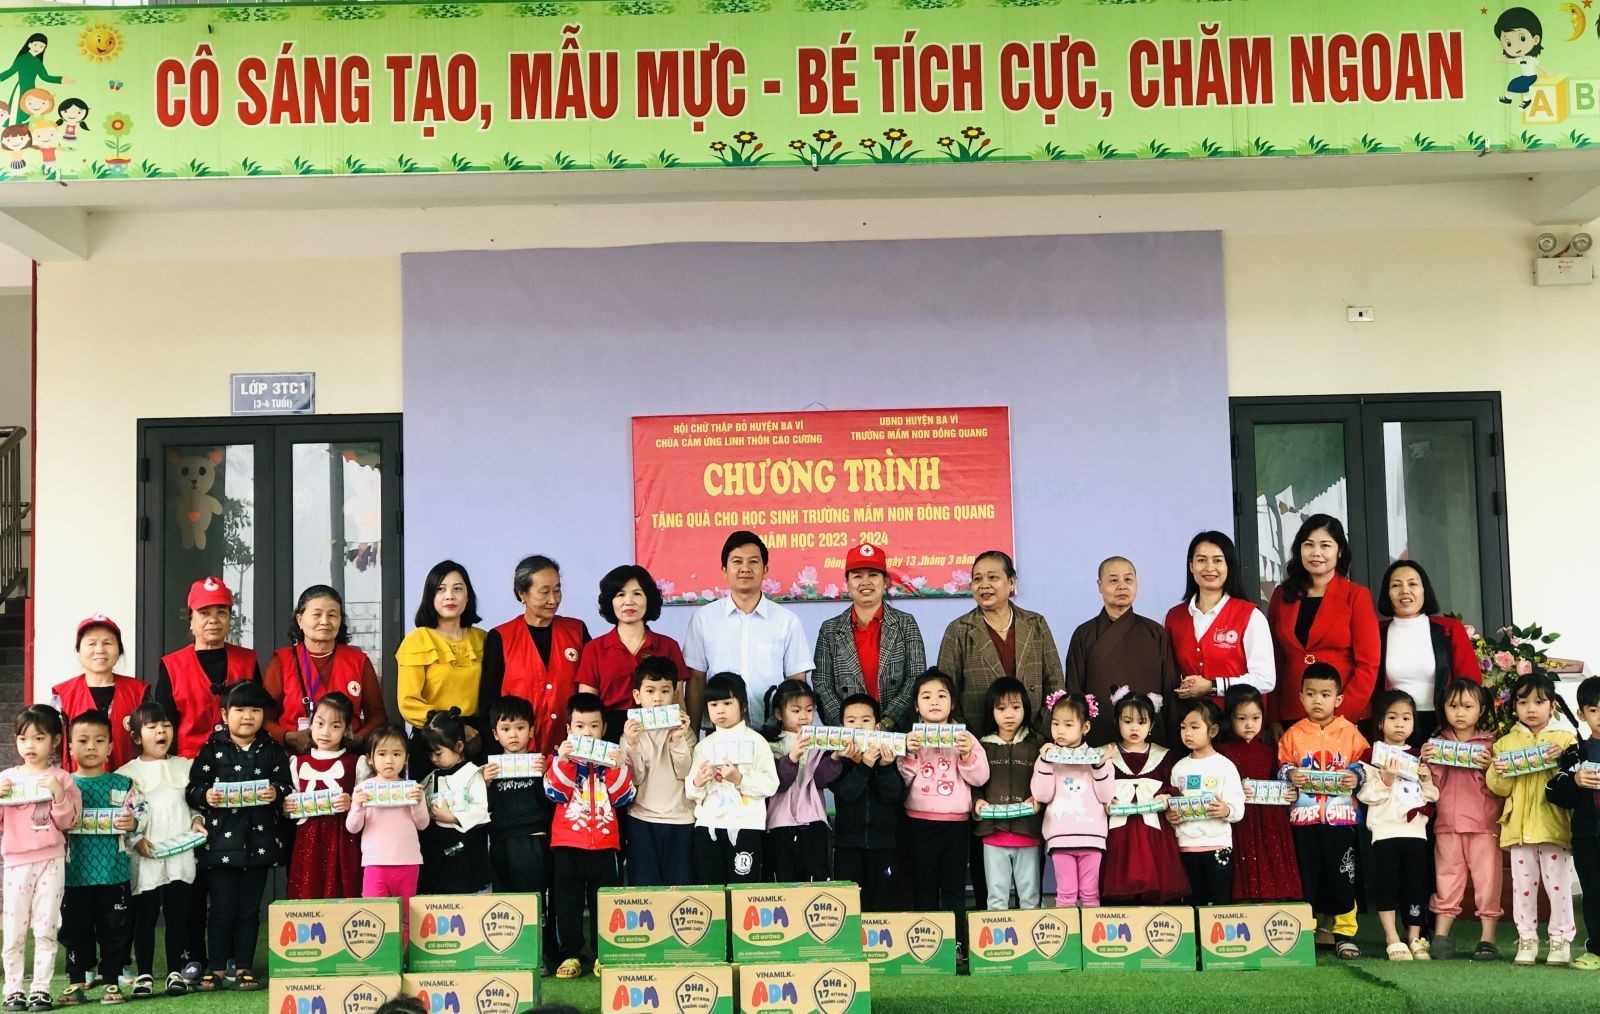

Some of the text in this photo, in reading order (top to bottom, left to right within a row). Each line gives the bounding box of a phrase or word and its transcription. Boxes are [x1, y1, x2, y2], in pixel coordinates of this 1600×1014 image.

[155, 43, 219, 127] CÔ
[237, 41, 370, 125] SÁNG
[385, 53, 493, 137] TẠO,
[510, 24, 621, 121] MẪU
[636, 42, 746, 133] MỰC
[799, 33, 859, 115] BÉ
[873, 29, 983, 113] TÍCH
[1000, 34, 1112, 126] CỰC,
[1128, 23, 1273, 110] CHĂM
[1291, 31, 1464, 105] NGOAN
[1529, 83, 1595, 117] A B
[240, 379, 306, 395] LỚP 3TC1
[253, 399, 270, 409] (3-4
[673, 418, 804, 435] HỘI CHỮ THẬP ĐỎ HUYỆN BA VÌ
[880, 413, 958, 427] UBND HUYỆN BA VÌ
[725, 436, 744, 446] LINH
[772, 435, 790, 445] CAO
[851, 429, 885, 441] TRƯỜNG
[911, 429, 930, 439] NON
[958, 427, 988, 438] QUANG
[703, 447, 941, 496] CHƯƠNG TRÌNH
[651, 510, 683, 532] TẶNG
[686, 508, 711, 529] QUÀ
[714, 511, 739, 526] CHO
[742, 510, 766, 529] HỌC
[769, 509, 799, 525] SINH
[802, 504, 850, 524] TRƯỜNG
[887, 506, 914, 521] NON
[917, 502, 950, 521] ĐÔNG
[954, 504, 995, 520] QUANG
[790, 532, 814, 550] HỌC
[818, 532, 848, 547] 2023
[859, 531, 889, 546] 2024
[885, 556, 901, 568] gày
[905, 555, 916, 566] 13
[948, 555, 954, 564] 3
[491, 912, 509, 920] DHA
[609, 908, 654, 933] ADM
[744, 905, 789, 930] ADM
[352, 920, 370, 928] DHA
[420, 913, 465, 939] ADM
[486, 922, 497, 931] 17
[280, 921, 326, 946] ADM
[346, 930, 358, 939] 17
[979, 926, 1018, 948] ADM
[1092, 922, 1131, 943] ADM
[1211, 922, 1250, 944] ADM
[685, 984, 703, 992] DHA
[823, 979, 841, 987] DHA
[353, 993, 371, 1001] DHA
[486, 989, 504, 997] DHA
[613, 985, 659, 1010] ADM
[680, 995, 691, 1003] 17
[752, 981, 797, 1007] ADM
[818, 990, 829, 998] 17
[347, 1004, 359, 1012] 17
[480, 1000, 491, 1008] 17
